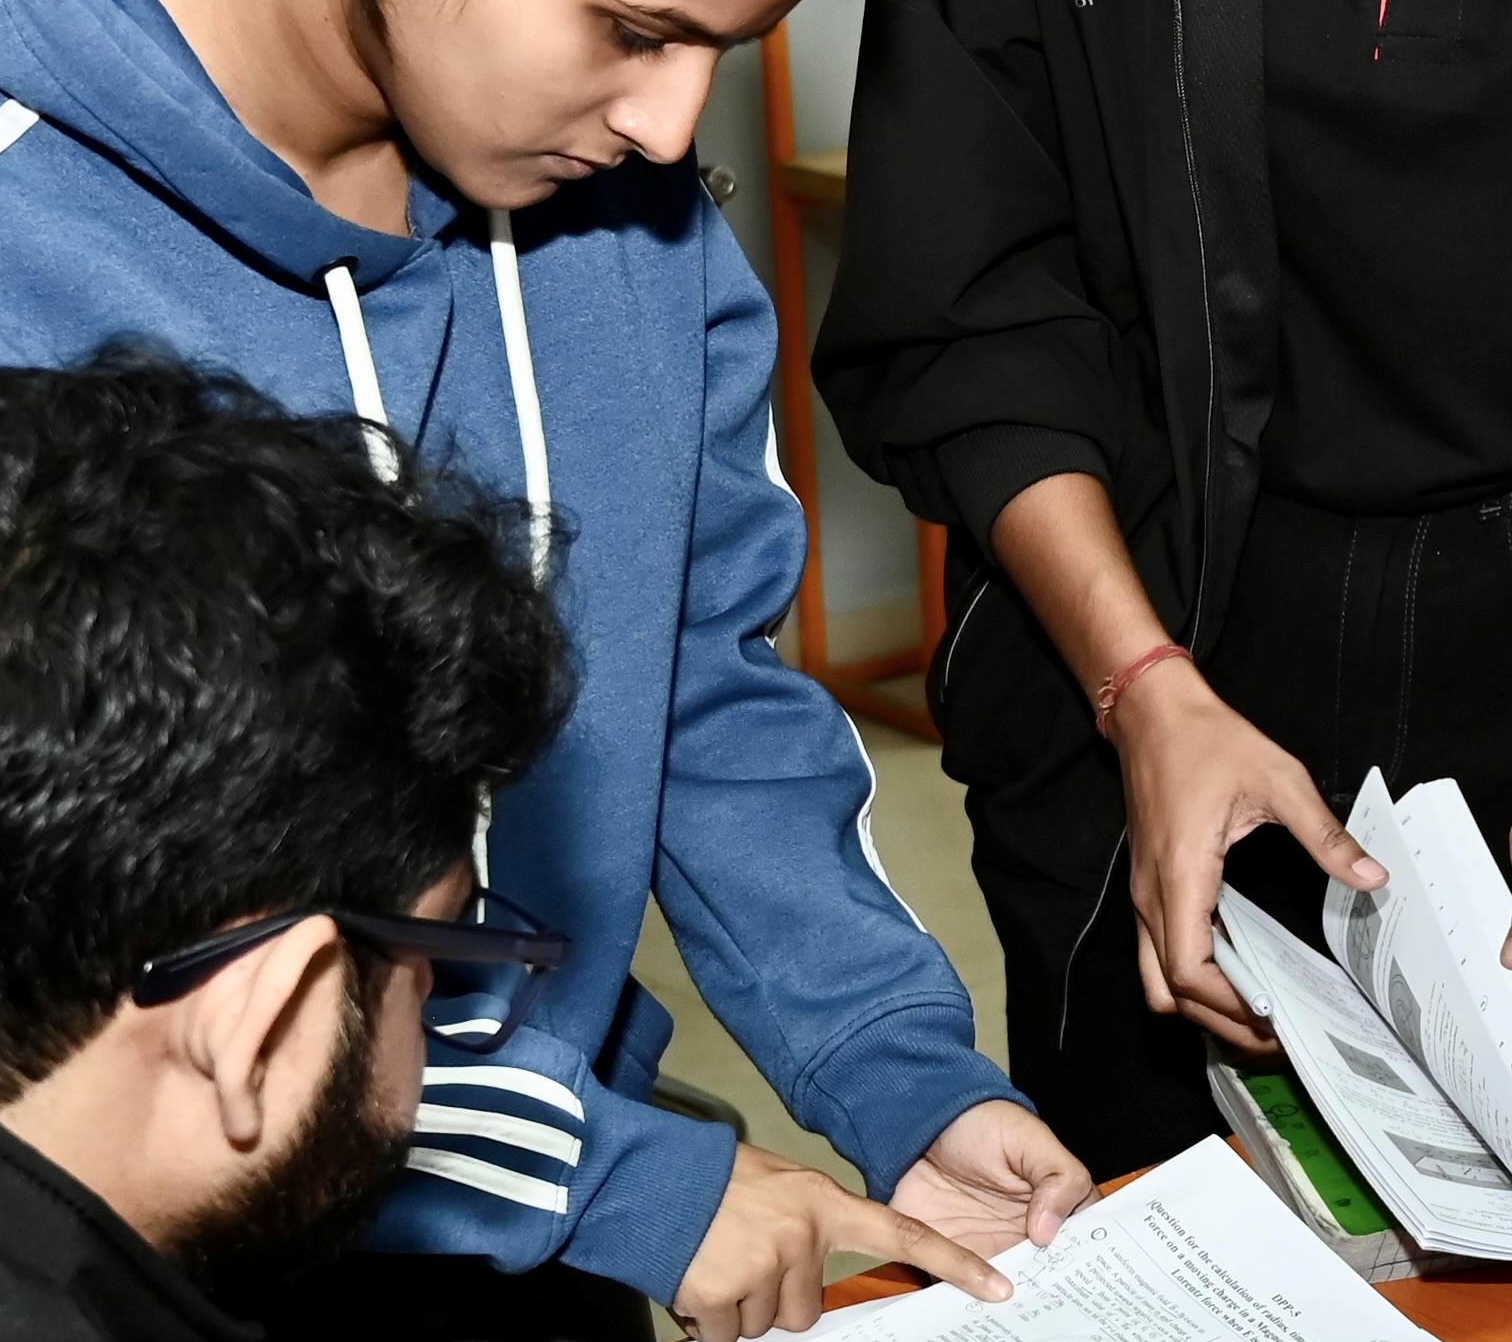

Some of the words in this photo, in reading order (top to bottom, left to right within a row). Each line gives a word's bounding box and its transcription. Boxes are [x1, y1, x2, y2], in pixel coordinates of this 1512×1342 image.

[1143, 1214, 1168, 1241] Force
[1167, 1239, 1179, 1254] on
[1184, 1259, 1216, 1289] moving
[1212, 1285, 1240, 1312] charge
[1171, 1268, 1202, 1299] Lorentz
[1201, 1291, 1223, 1315] force
[1185, 1235, 1199, 1251] for
[1197, 1247, 1213, 1266] the
[1211, 1262, 1254, 1303] calculation
